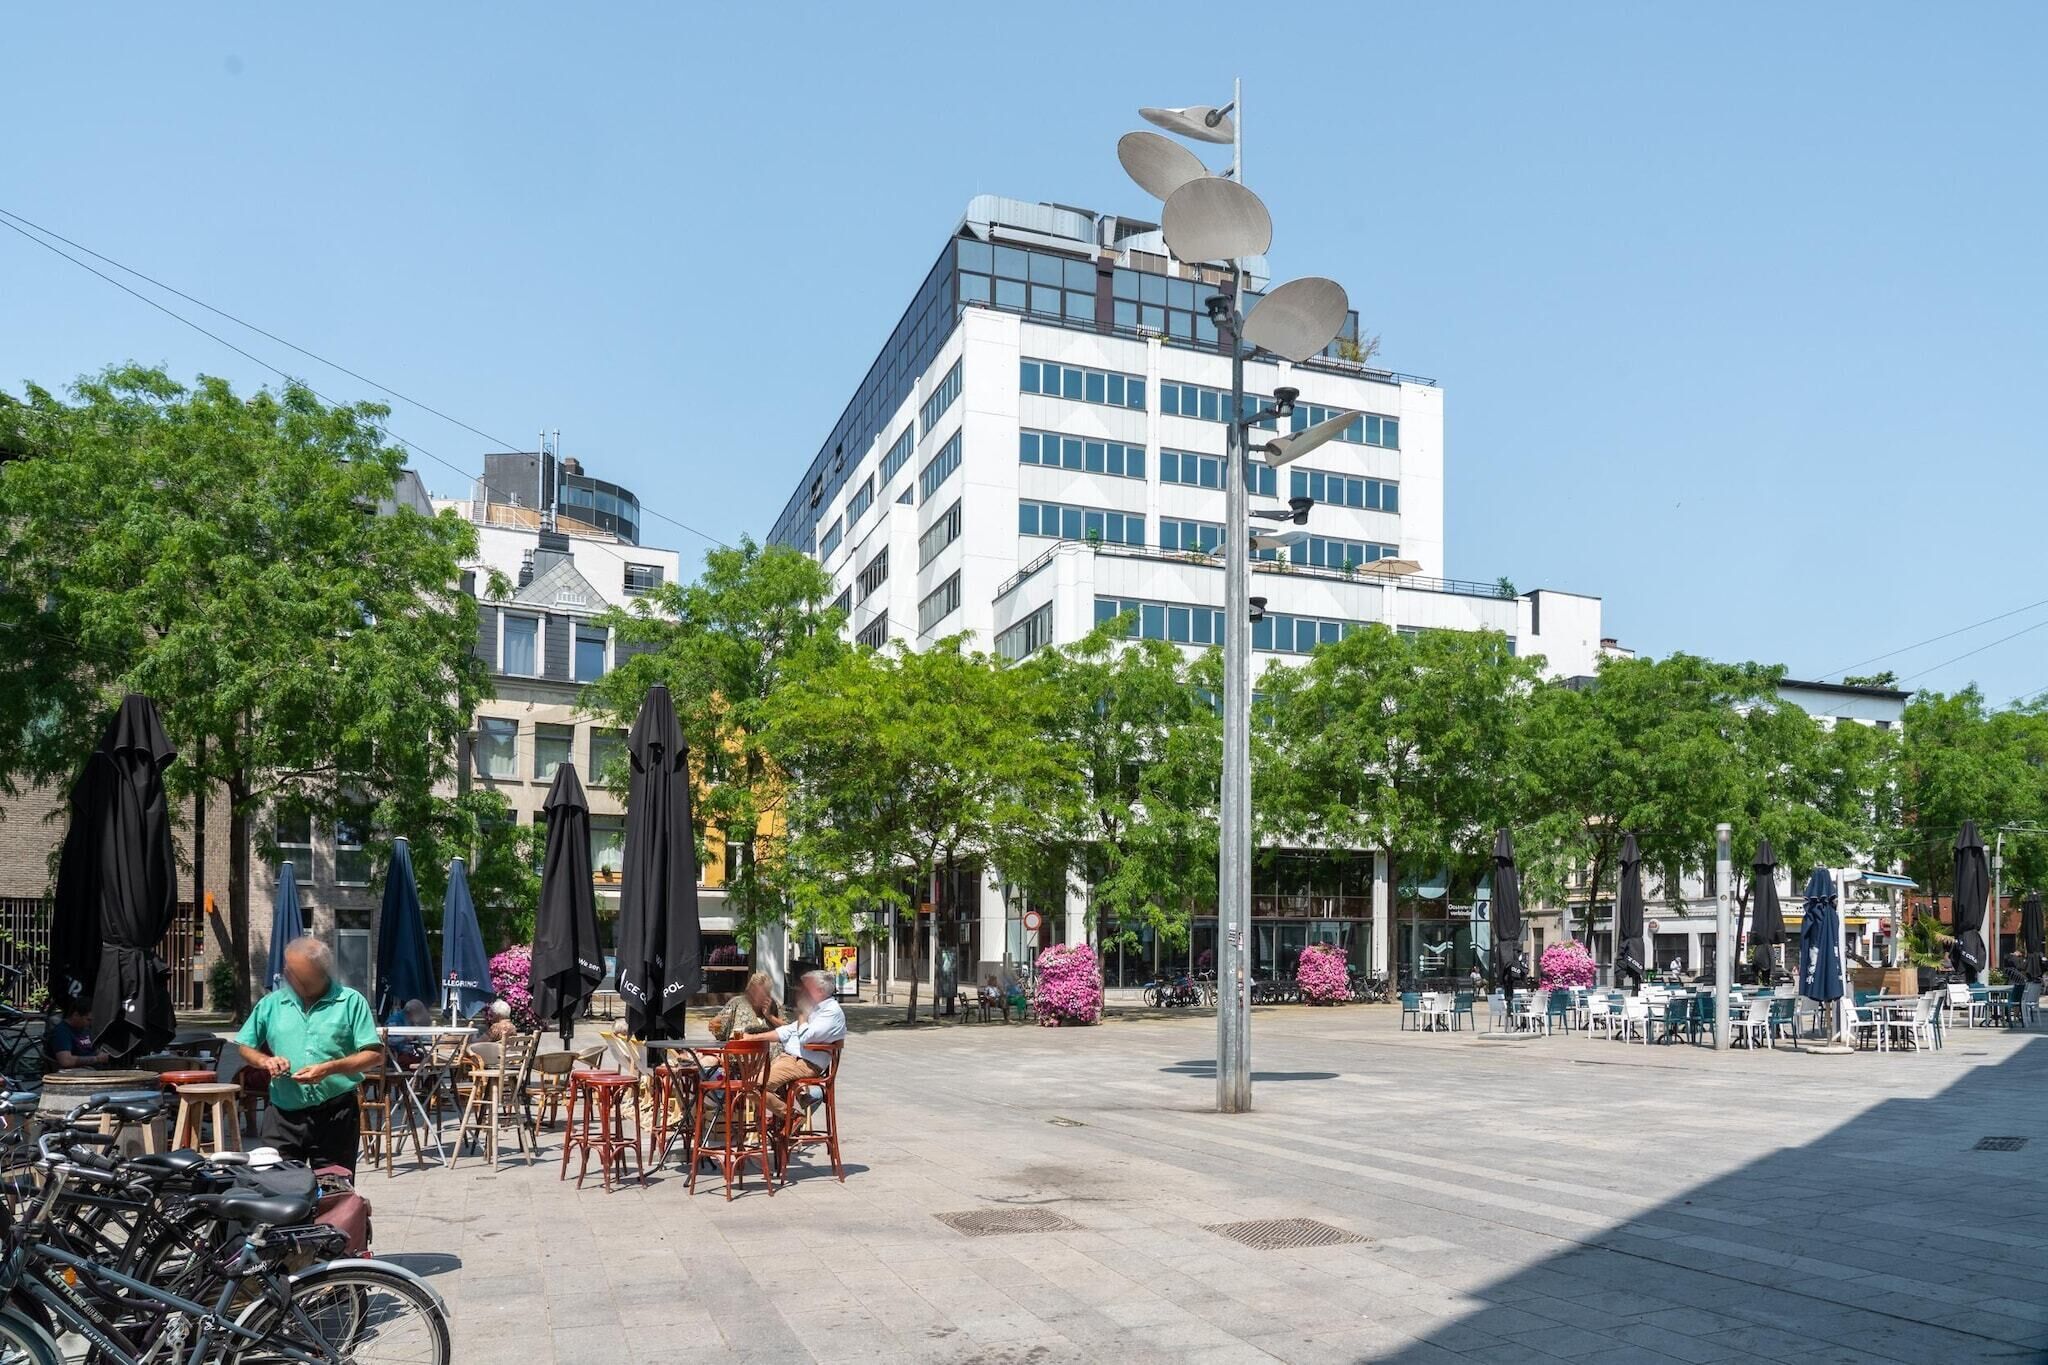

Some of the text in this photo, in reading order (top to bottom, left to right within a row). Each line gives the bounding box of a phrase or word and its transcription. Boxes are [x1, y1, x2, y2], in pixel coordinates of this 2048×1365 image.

[623, 980, 641, 996] ICE
[44, 1267, 86, 1309] KETTLER
[79, 1323, 115, 1354] SWAPFIETS
